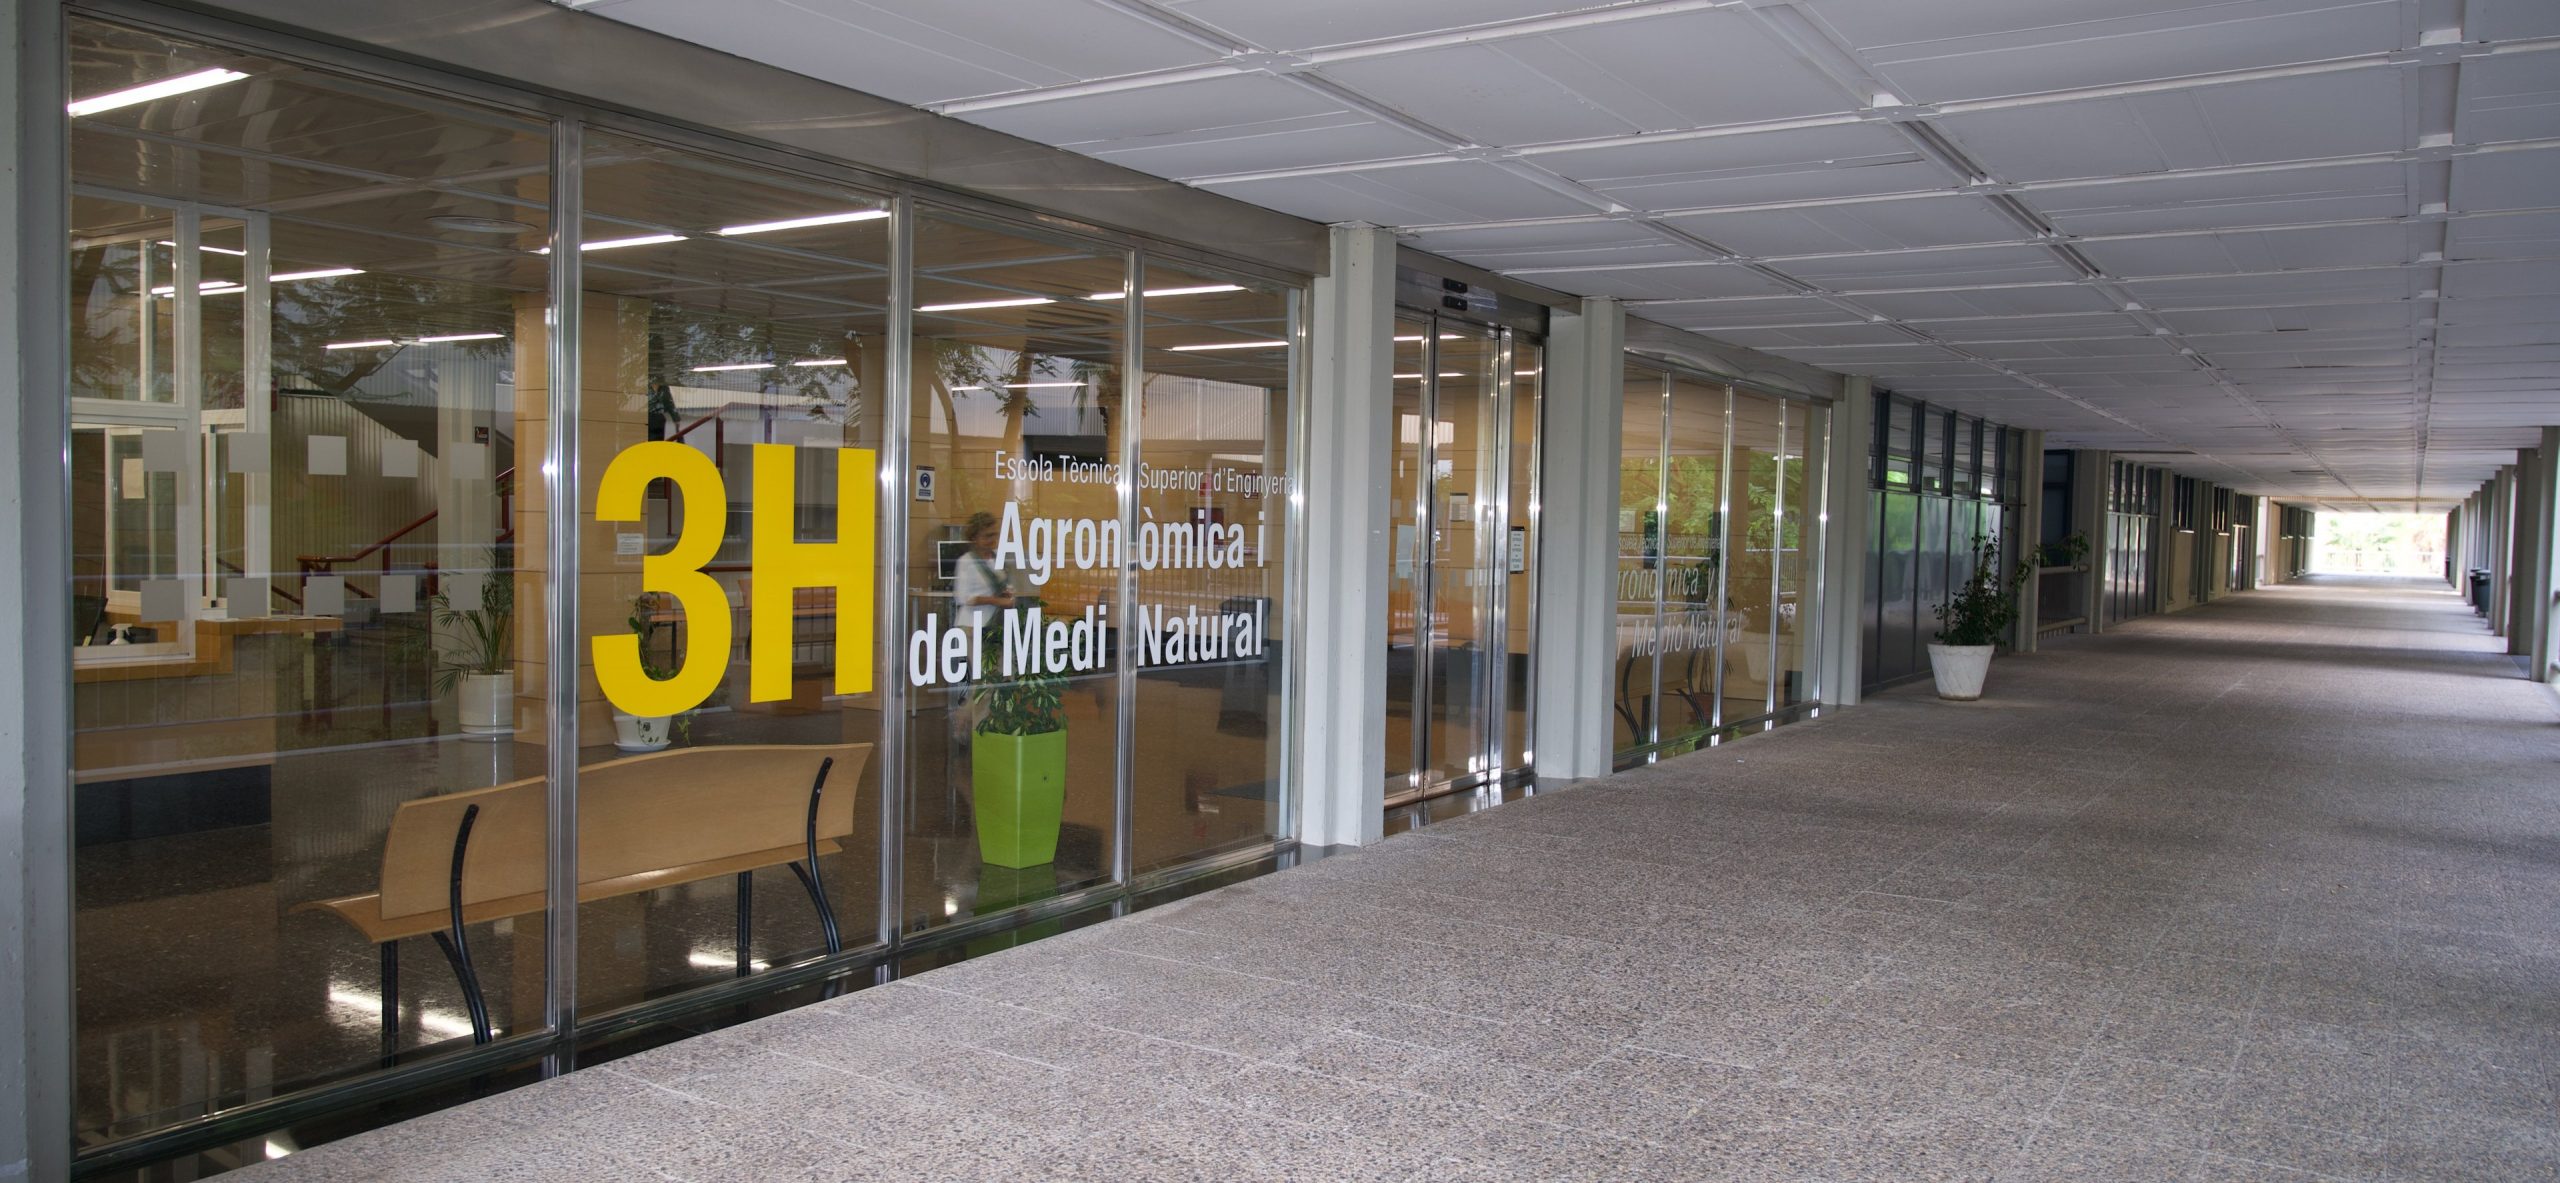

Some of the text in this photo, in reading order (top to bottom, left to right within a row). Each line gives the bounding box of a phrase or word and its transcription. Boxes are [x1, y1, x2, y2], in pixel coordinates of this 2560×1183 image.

[995, 450, 1053, 482] Escola
[1059, 454, 1121, 485] Tècnica
[1140, 462, 1204, 494] Superior
[1257, 511, 1265, 568] i
[591, 440, 876, 718] 3H
[909, 599, 1263, 687] del Medi Natural
[1686, 609, 1744, 650] Natural
